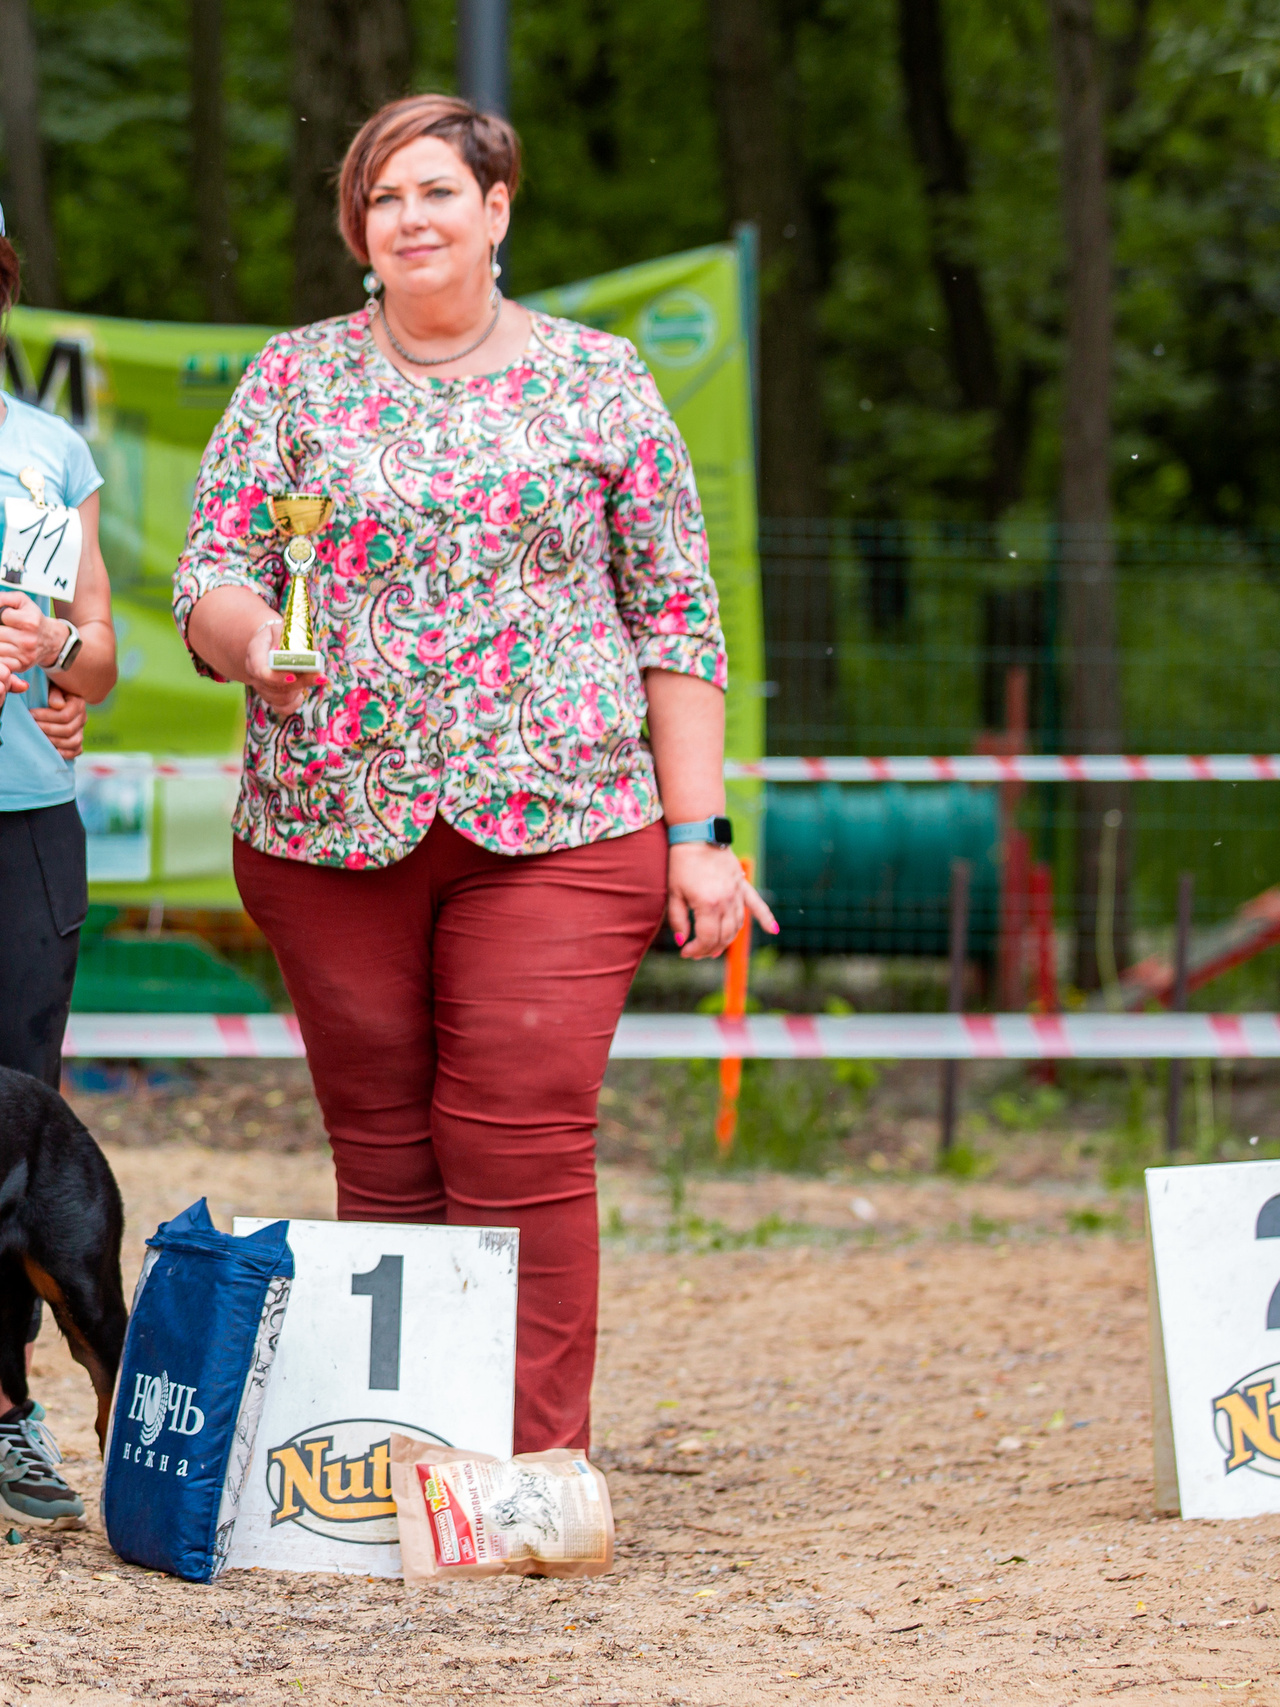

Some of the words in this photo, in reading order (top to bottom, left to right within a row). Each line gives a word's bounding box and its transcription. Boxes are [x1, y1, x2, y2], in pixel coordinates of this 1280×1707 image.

[19, 512, 70, 574] 11
[350, 1254, 404, 1391] 1
[128, 1371, 205, 1437] НОЧЬ
[269, 1438, 396, 1523] Nut
[436, 1511, 455, 1561] ЗООМЕНЮ
[469, 1486, 487, 1559] ПРОТЕИНОВЫЕ
